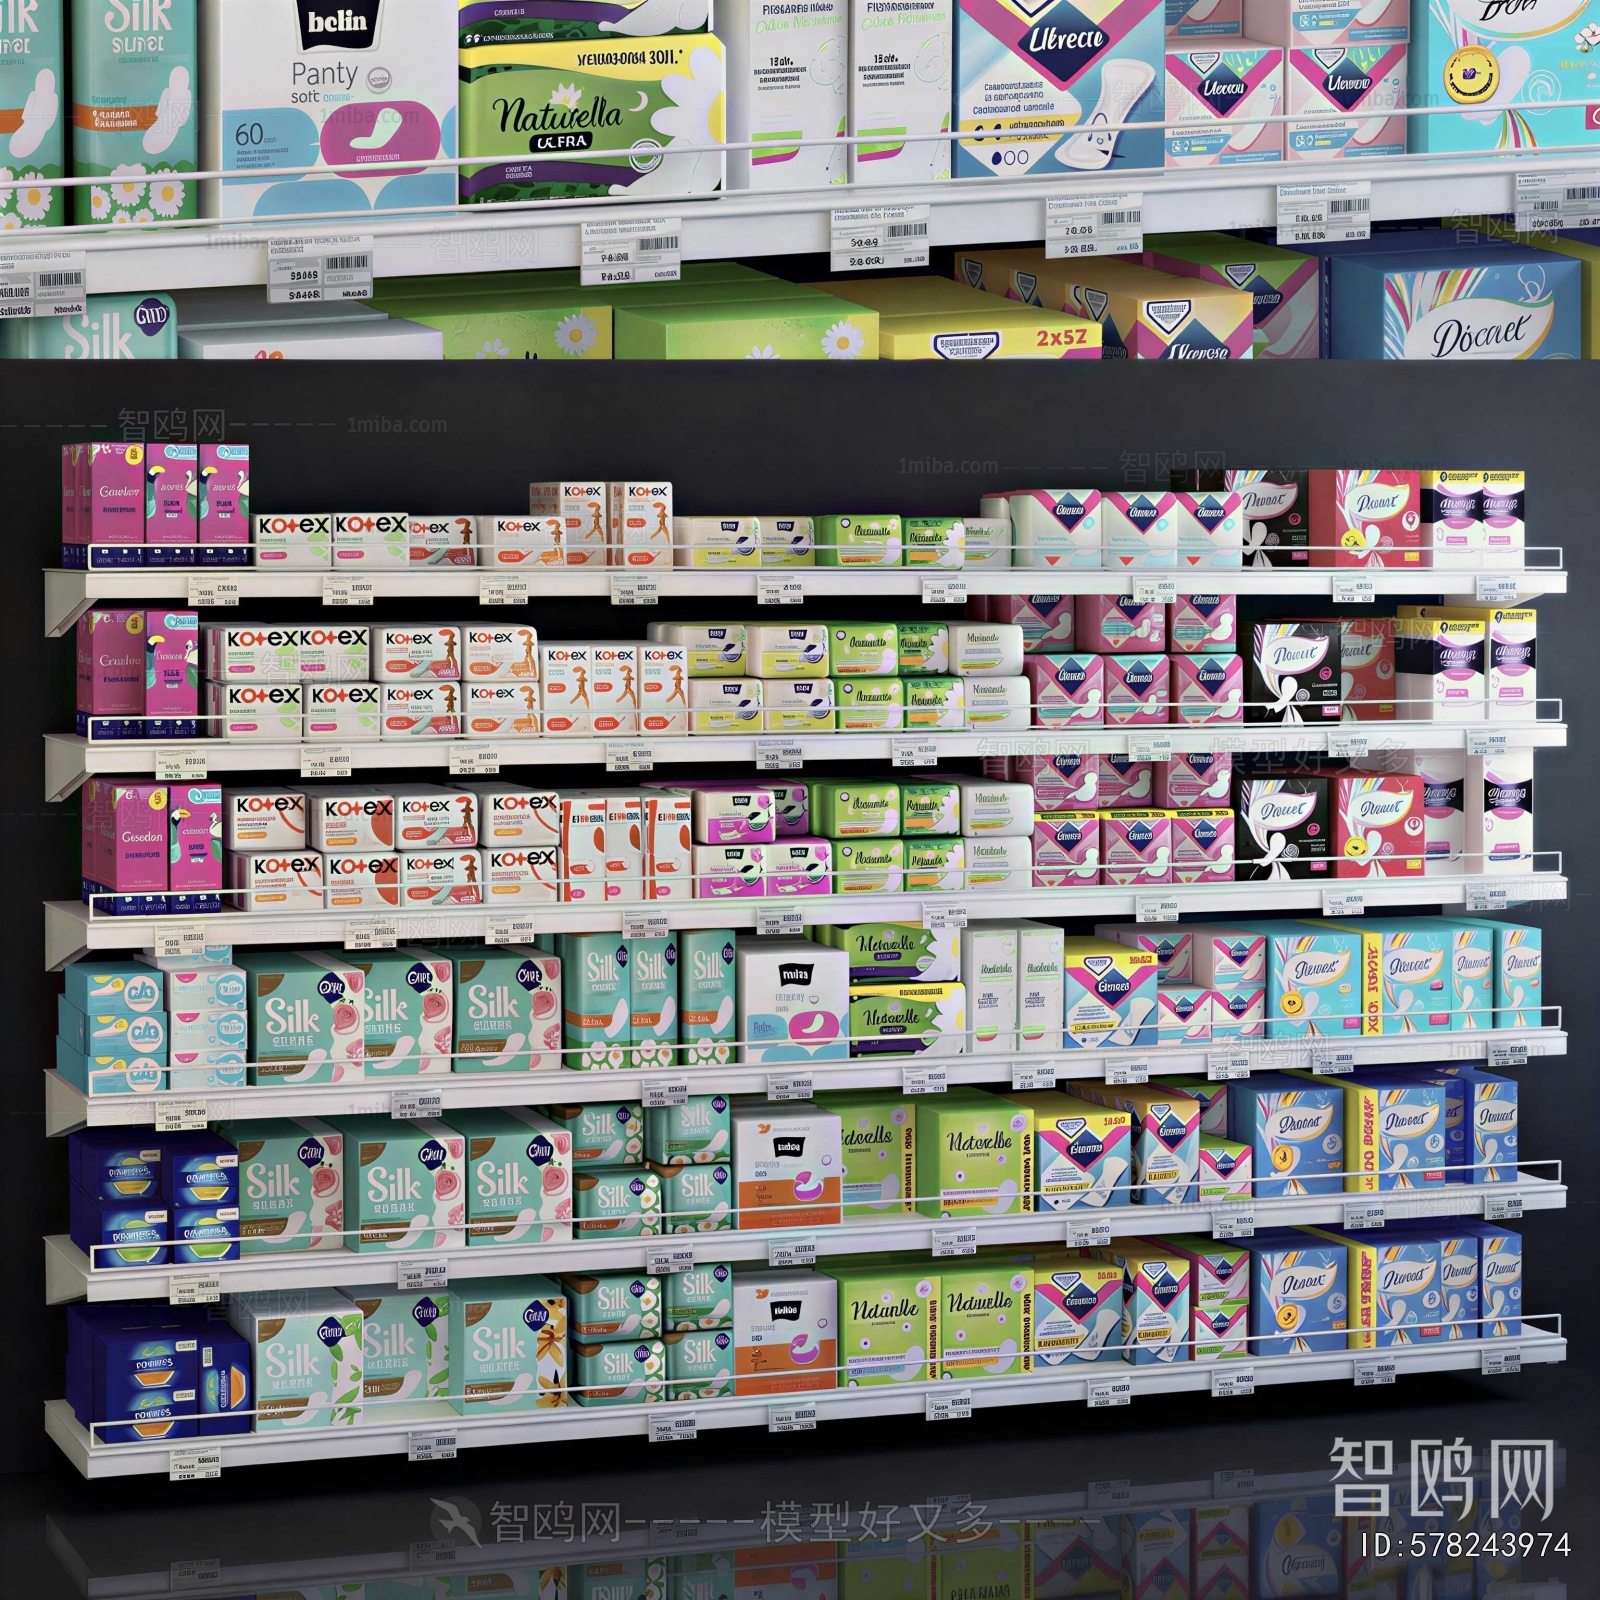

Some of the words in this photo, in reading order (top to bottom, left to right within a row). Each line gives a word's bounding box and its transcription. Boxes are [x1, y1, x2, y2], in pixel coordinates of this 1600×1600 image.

[292, 61, 358, 86] Panty
[235, 122, 264, 146] 60
[586, 951, 620, 982] Silk
[636, 950, 668, 982] Silk
[694, 950, 725, 980] Silk
[265, 997, 321, 1035] Silk
[468, 984, 520, 1020] Silk
[582, 1112, 617, 1137] Silk
[246, 1162, 300, 1199] Silk
[367, 1166, 422, 1202] Silk
[477, 1161, 529, 1197] Silk
[681, 1173, 715, 1197] Silk
[597, 1185, 630, 1208] Silk
[597, 1286, 630, 1310] Silk
[682, 1272, 716, 1296] Silk
[472, 1326, 526, 1362] Silk
[684, 1339, 717, 1364] Silk
[265, 1343, 321, 1379] Silk
[603, 1349, 634, 1374] Silk
